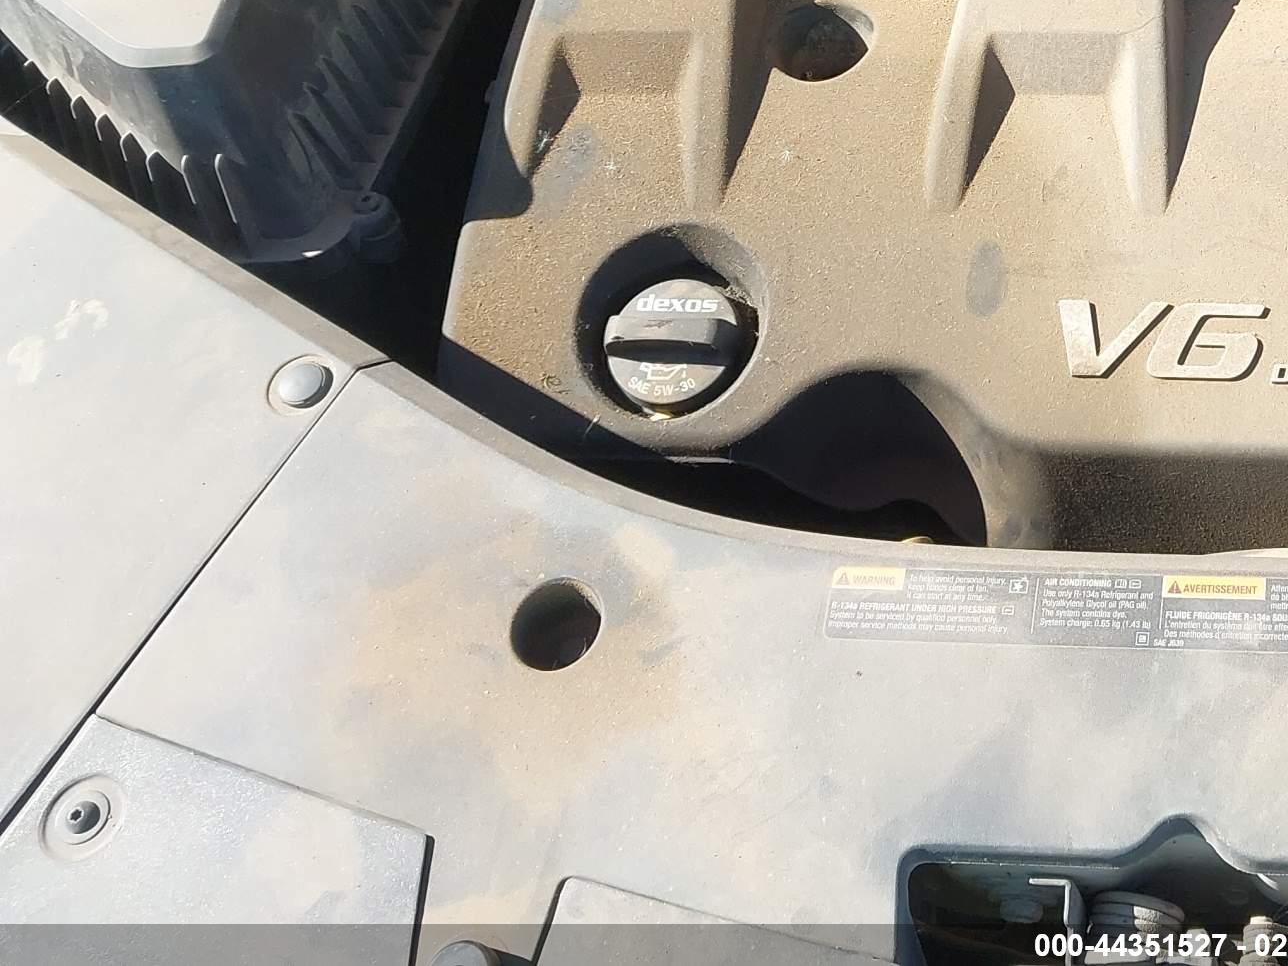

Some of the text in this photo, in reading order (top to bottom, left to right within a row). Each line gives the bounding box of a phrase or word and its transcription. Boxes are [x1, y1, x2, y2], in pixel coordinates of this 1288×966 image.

[636, 294, 719, 313] dexos
[1058, 299, 1270, 382] V6
[628, 376, 696, 396] SAE 5W-30
[853, 575, 897, 586] WARNING
[935, 574, 954, 583] avoid
[955, 575, 985, 586] personal
[1044, 577, 1112, 587] AIR CONDITIONING
[1057, 589, 1072, 599] only
[1073, 589, 1099, 598] R-134a
[1101, 590, 1139, 601] Refrigerant
[1140, 591, 1154, 600] and
[1183, 584, 1259, 595] AVERTISSEMENT
[859, 602, 910, 611] REFRIGERANT
[911, 603, 937, 612] UNDER
[938, 604, 957, 612] HIGH
[958, 604, 997, 613] PRESSURE
[1086, 600, 1106, 610] Glycol
[1118, 600, 1135, 610] (PAG
[1082, 609, 1111, 617] contains
[1165, 611, 1193, 620] FLUIDE
[1243, 613, 1271, 622] R-134a
[1040, 618, 1065, 629] System
[1163, 629, 1177, 638] Des
[1153, 638, 1167, 647] SAE
